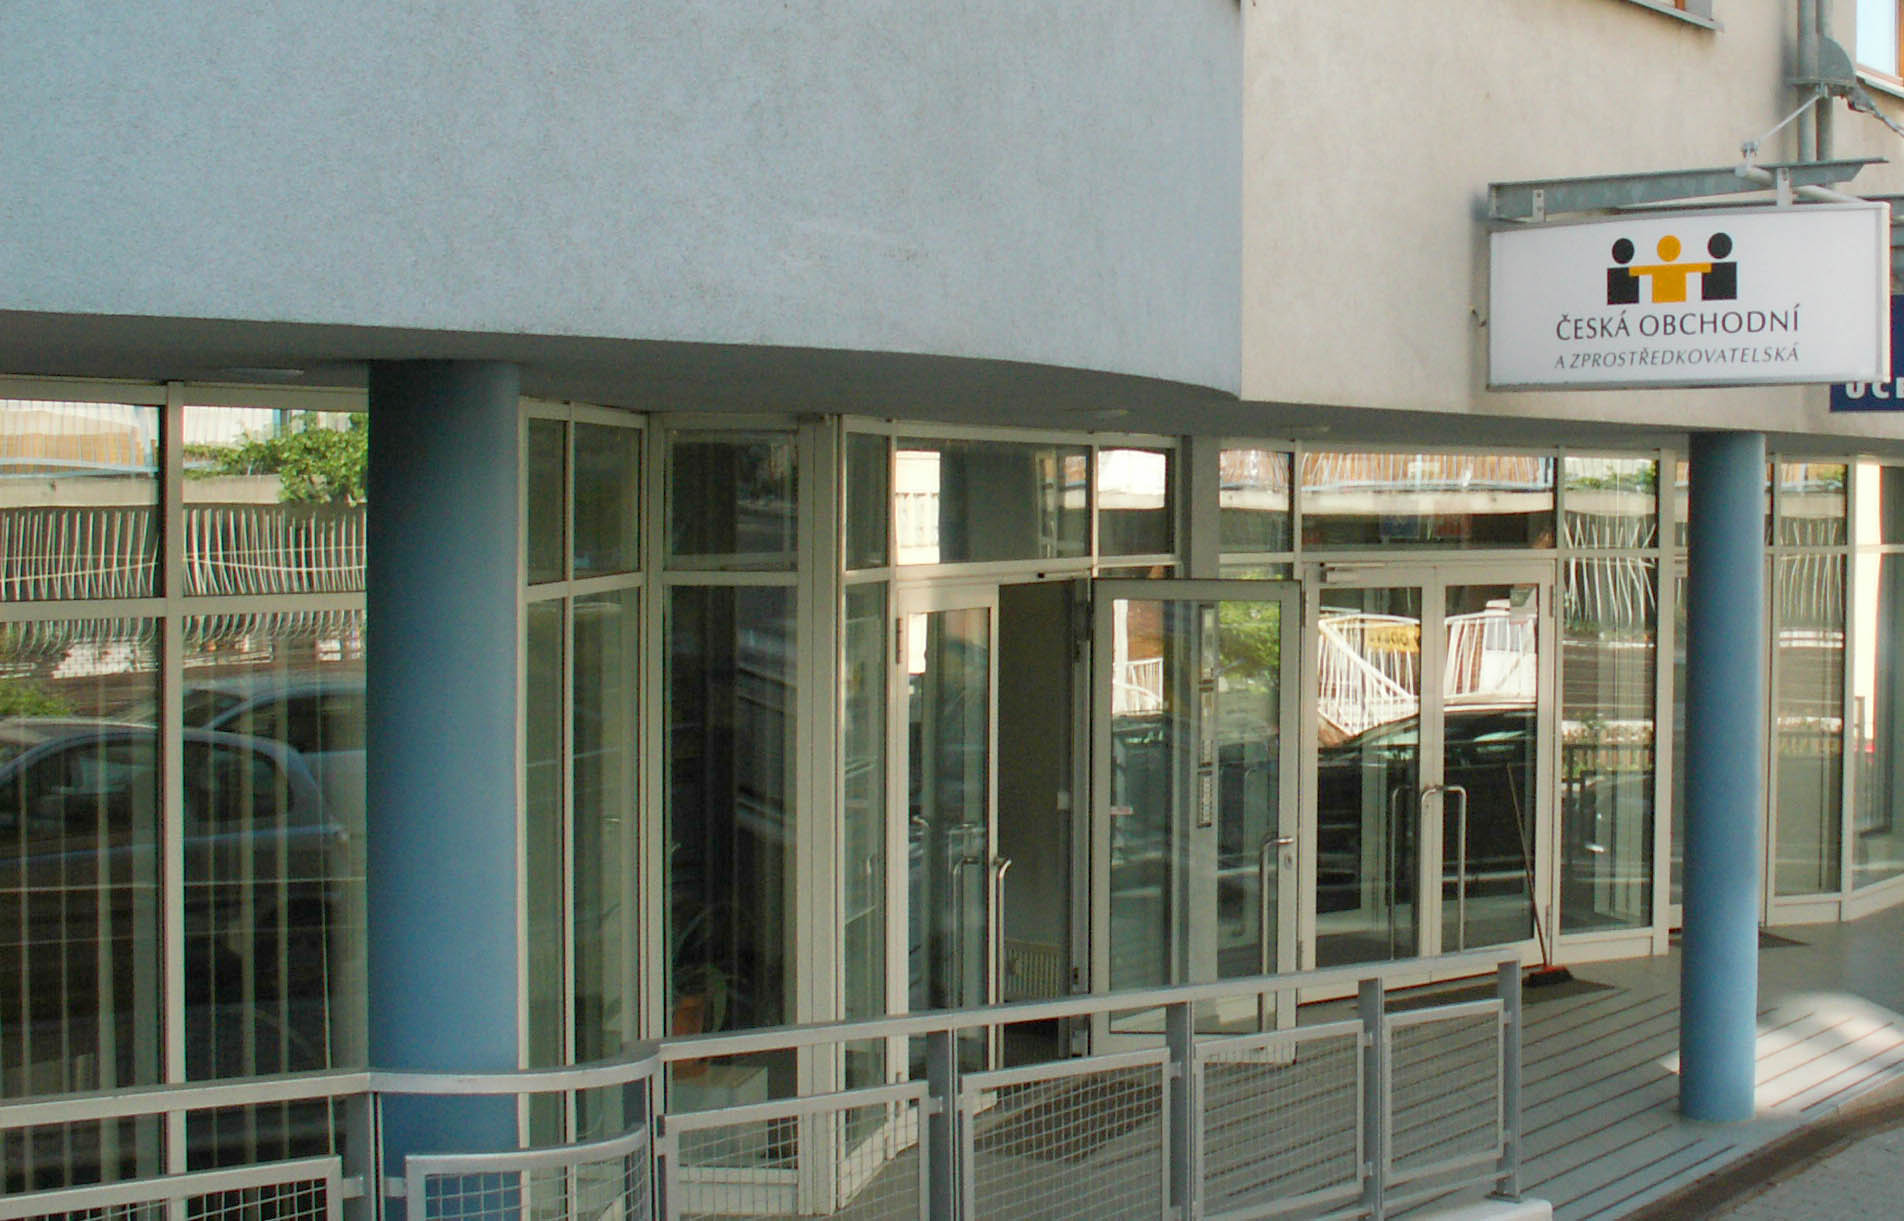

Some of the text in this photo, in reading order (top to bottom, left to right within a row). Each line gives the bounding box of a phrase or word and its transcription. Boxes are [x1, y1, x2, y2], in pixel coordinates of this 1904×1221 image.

[1556, 303, 1800, 341] ČESKÁ OBCHODNÍ
[1554, 343, 1800, 369] A ZPROSTŘEDKOVATELSKÁ
